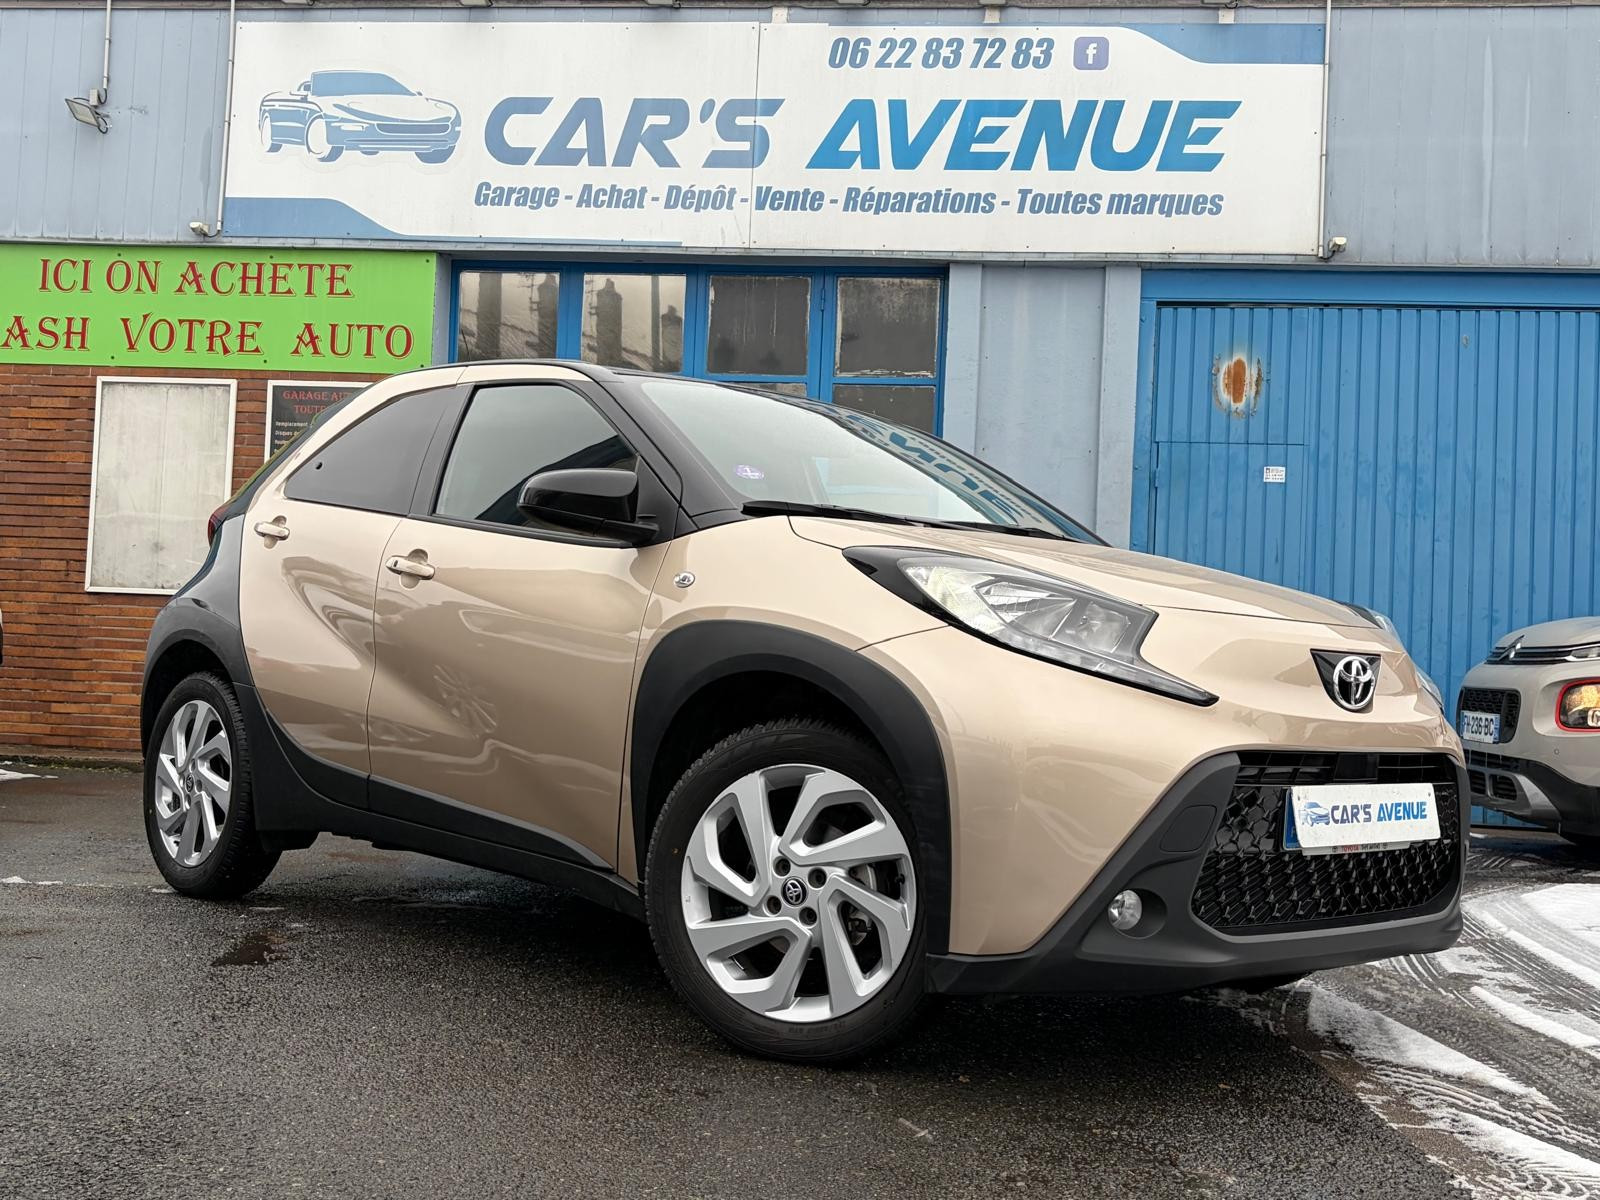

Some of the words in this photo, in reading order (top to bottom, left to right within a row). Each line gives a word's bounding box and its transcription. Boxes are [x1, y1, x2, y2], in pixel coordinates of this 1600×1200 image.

[829, 38, 871, 69] 06
[874, 38, 917, 69] 22
[921, 38, 964, 69] 83
[969, 38, 1007, 69] 72
[1011, 38, 1055, 70] 83
[484, 96, 786, 169] CAR'S
[805, 98, 1242, 173] AVENUE
[474, 181, 560, 210] Garage
[576, 183, 648, 210] Achat
[664, 184, 737, 213] Dépôt
[755, 185, 825, 212] Vente
[843, 186, 997, 216] Réparations
[1016, 188, 1102, 215] Toutes
[1106, 192, 1224, 218] marques
[39, 259, 92, 293] ICI
[105, 260, 161, 294] ON
[174, 261, 353, 297] ACHETE
[120, 312, 263, 356] VOTRE
[290, 322, 414, 359] AUTO
[283, 391, 328, 401] GARAGE
[1330, 804, 1372, 825] CAR'S
[1377, 801, 1428, 822] AVENUE
